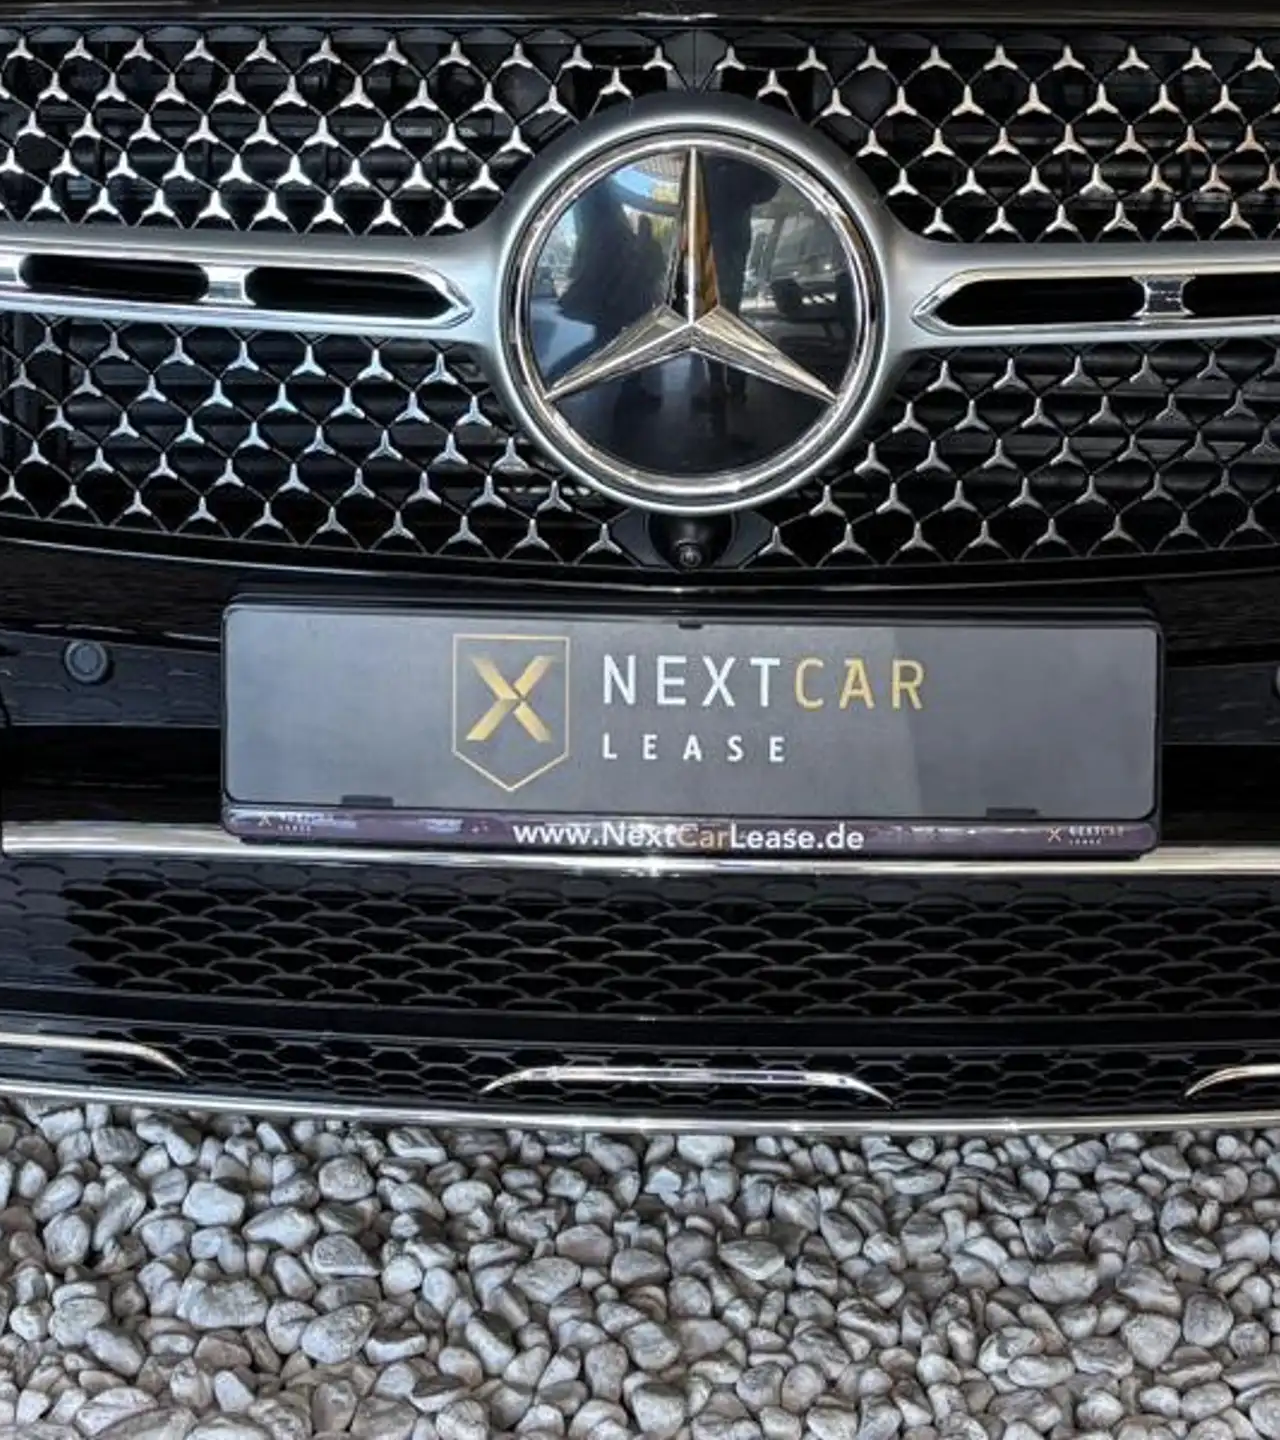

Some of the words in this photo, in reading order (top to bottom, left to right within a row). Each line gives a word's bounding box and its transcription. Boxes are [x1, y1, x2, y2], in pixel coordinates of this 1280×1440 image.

[602, 654, 925, 709] NEXTCAR
[602, 732, 786, 762] LEASE
[512, 821, 866, 850] www.NextCarLease.de
